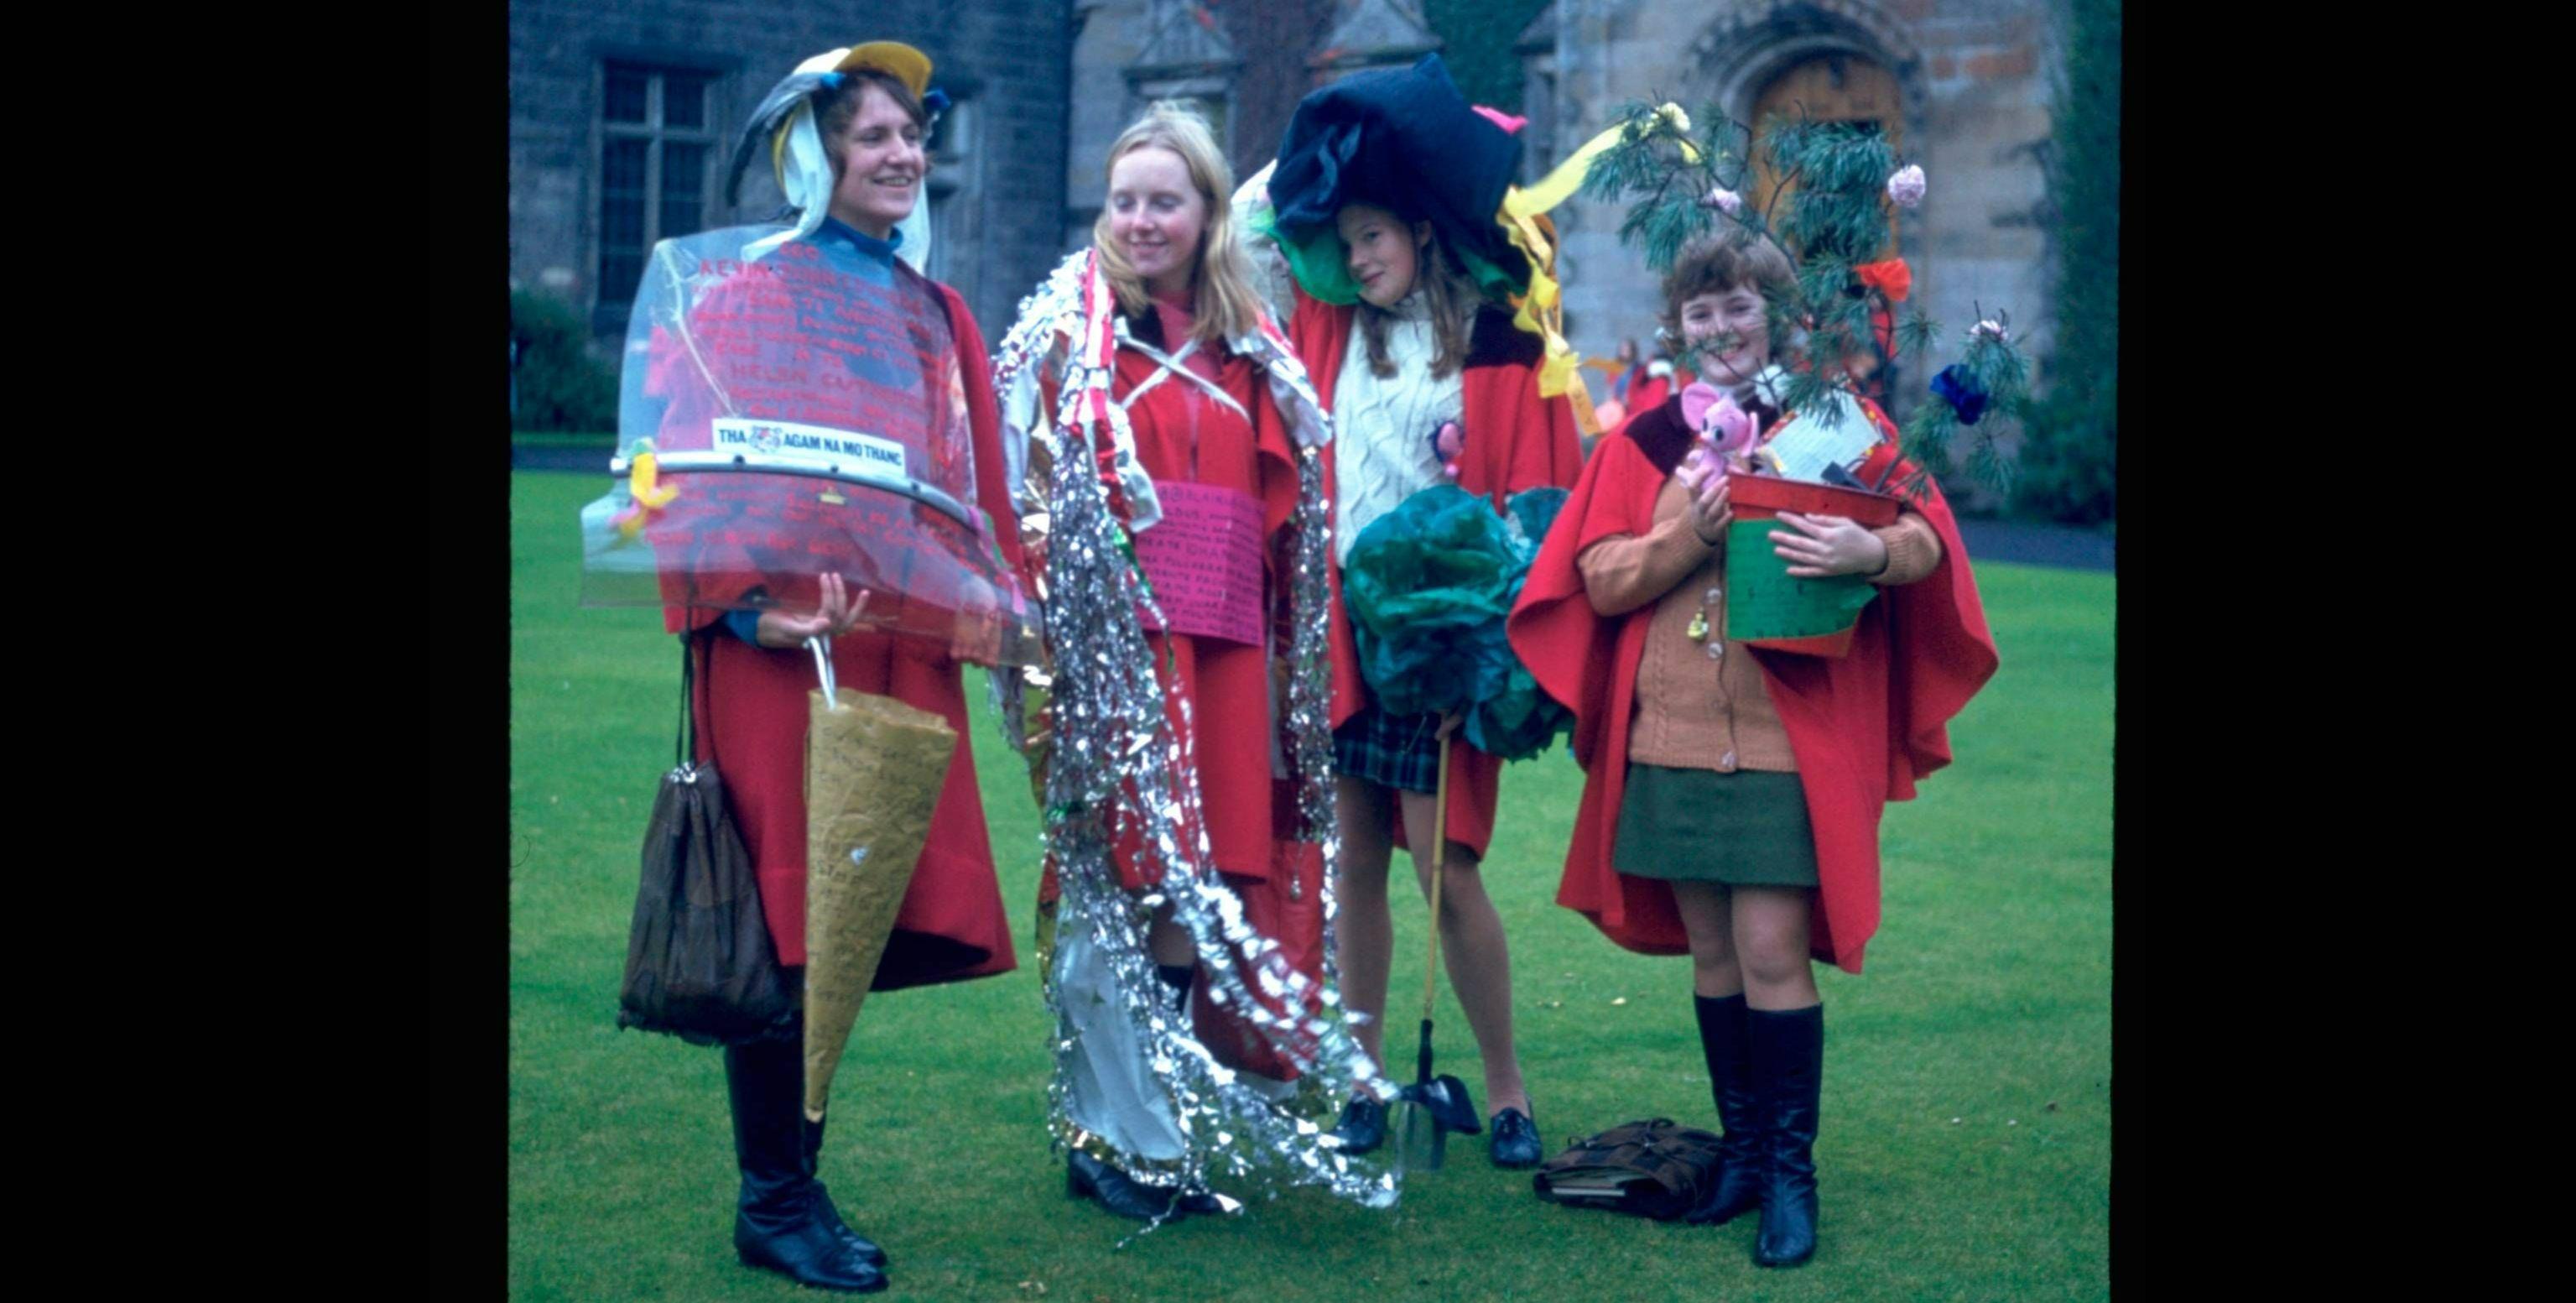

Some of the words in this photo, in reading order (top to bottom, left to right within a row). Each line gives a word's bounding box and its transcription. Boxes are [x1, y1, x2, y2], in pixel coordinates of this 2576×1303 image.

[700, 258, 769, 277] KEVIN
[718, 429, 747, 443] THA
[783, 433, 820, 450] AGAM
[824, 438, 840, 452] NA
[843, 441, 862, 456] MO
